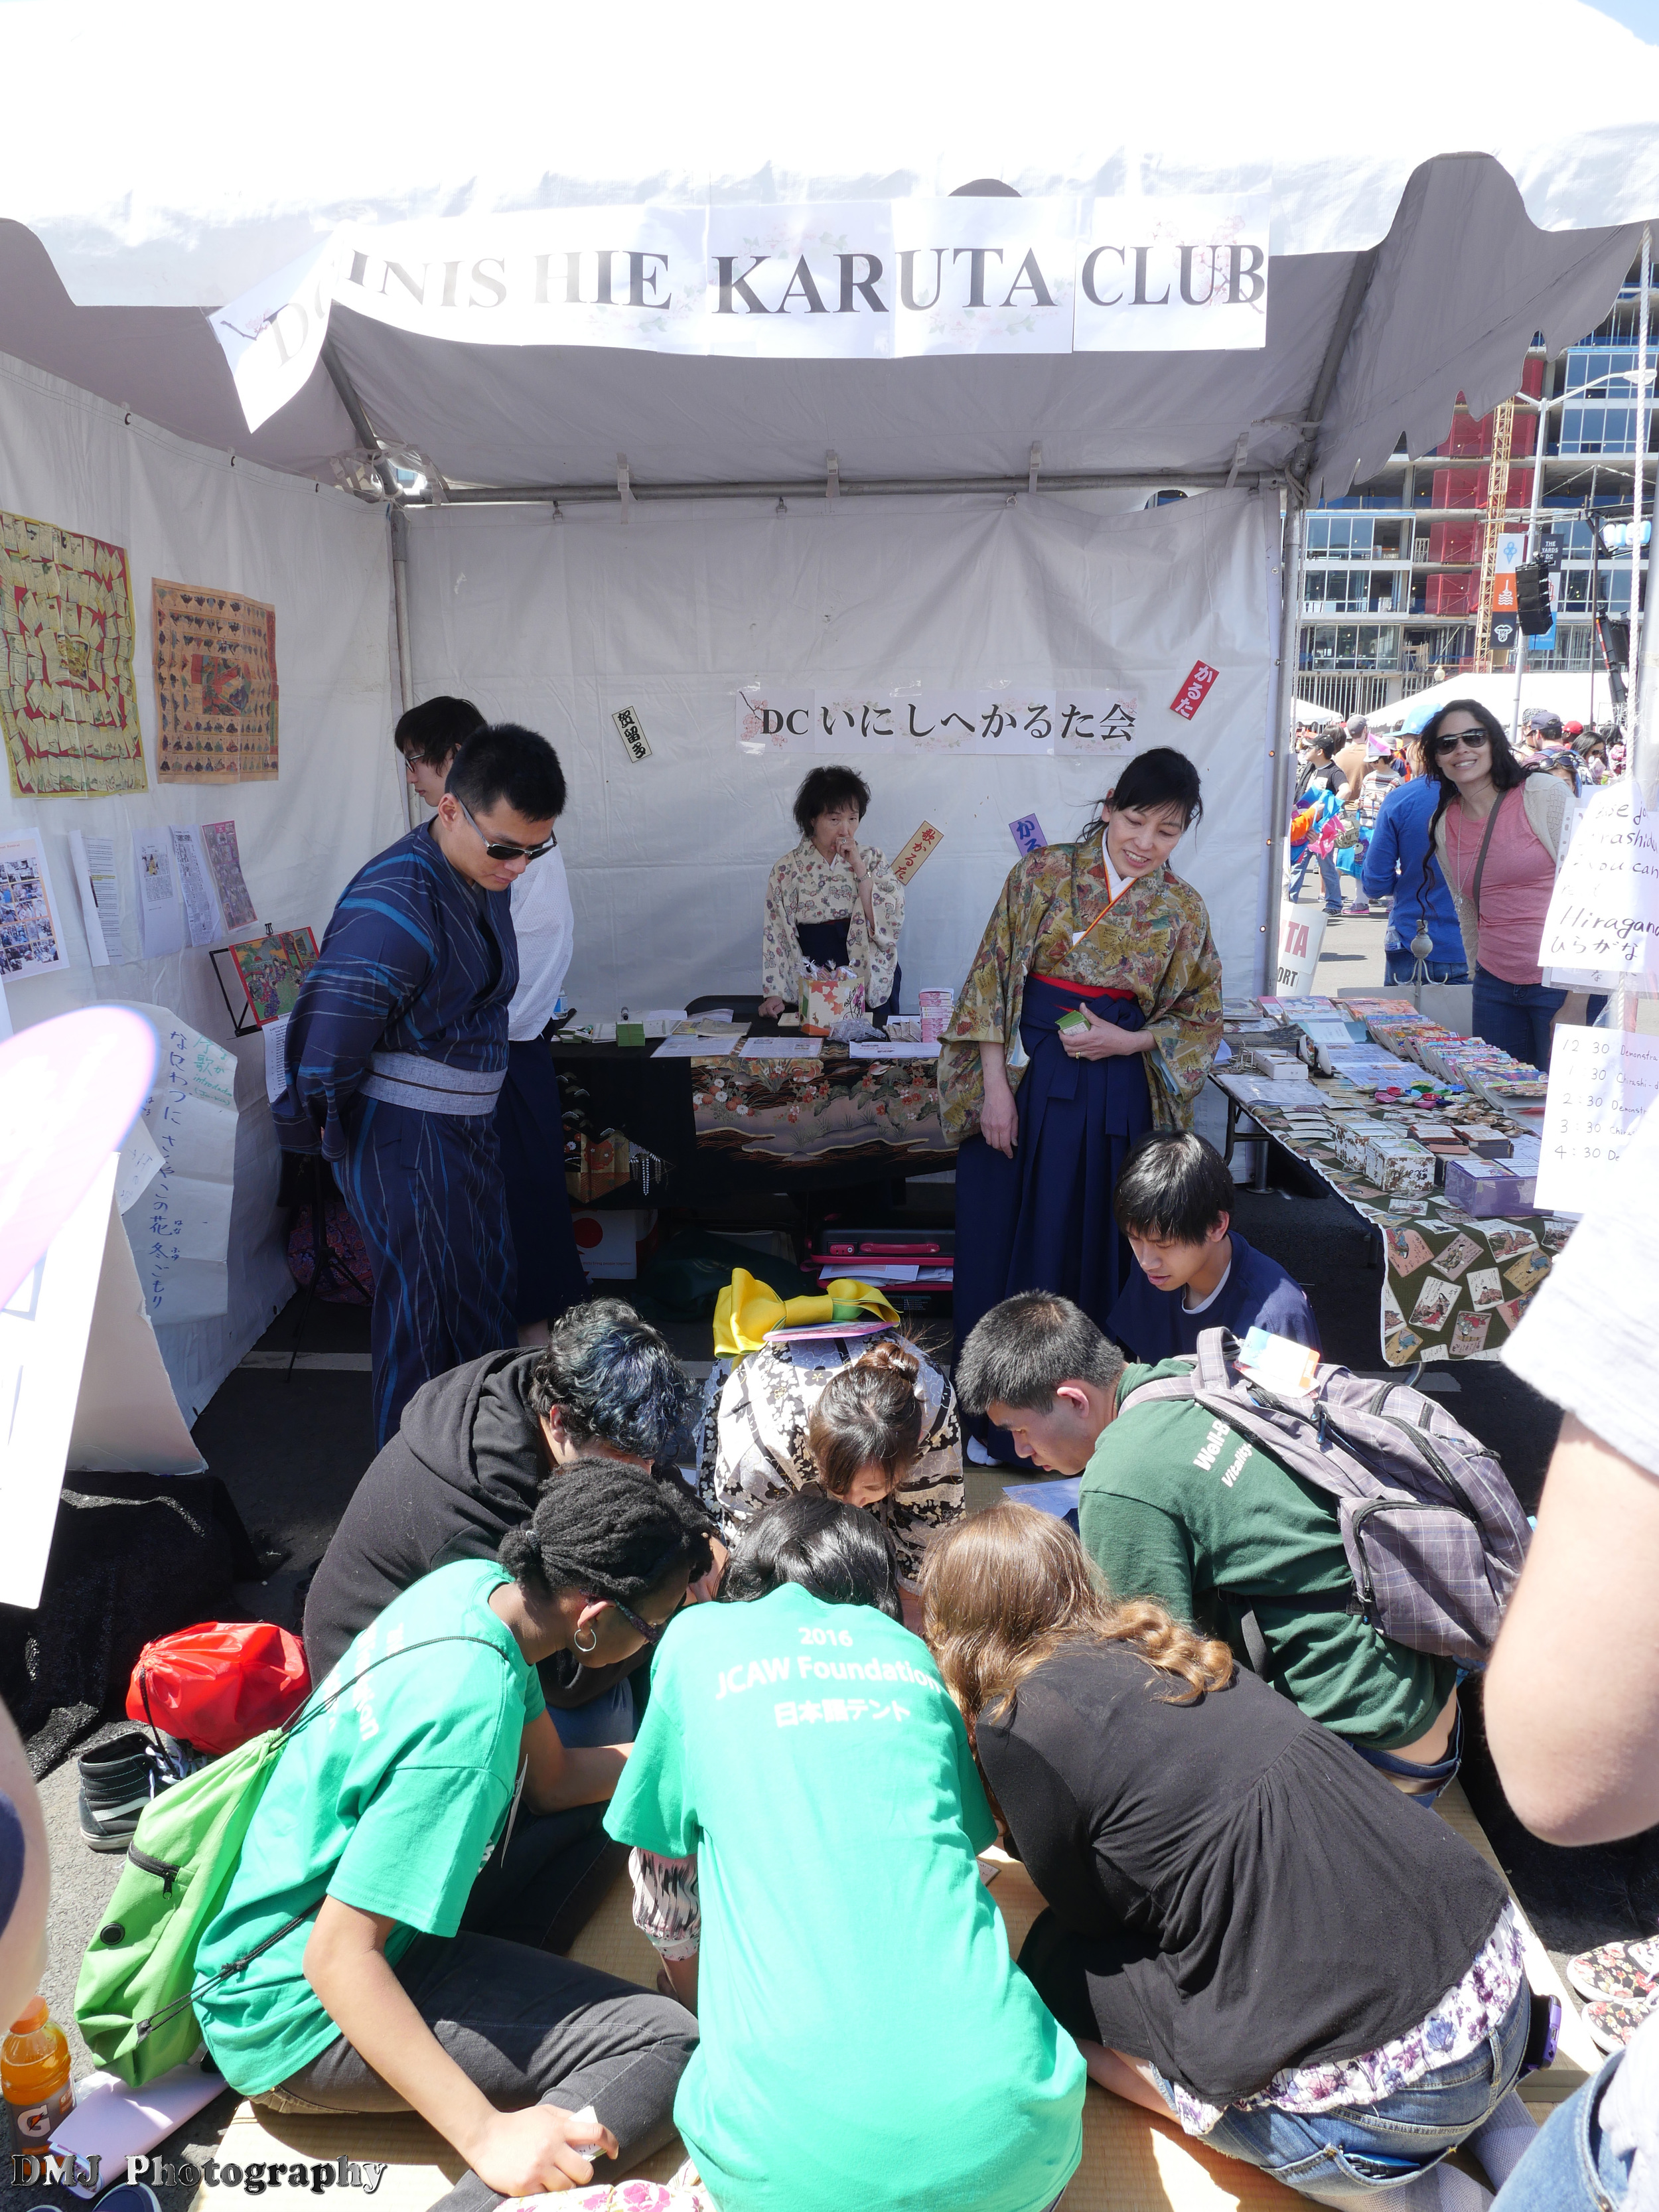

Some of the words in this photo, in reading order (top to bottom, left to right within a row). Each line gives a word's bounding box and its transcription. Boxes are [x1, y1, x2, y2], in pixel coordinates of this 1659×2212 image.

[711, 247, 1057, 314] KARUTA
[1082, 244, 1265, 307] CLUB
[1175, 665, 1213, 718] かるた
[617, 709, 646, 759] 賀留多
[821, 703, 1137, 741] いにしへかるた会
[895, 828, 936, 880] 歌かるた
[1551, 936, 1639, 961] ひらがな
[1620, 1045, 1659, 1061] Demonstra
[798, 1627, 853, 1647] 2016
[715, 1657, 791, 1700] JCAW
[797, 1657, 941, 1694] Foundation
[774, 1698, 910, 1728] 日本語テント
[17, 2104, 51, 2138] G
